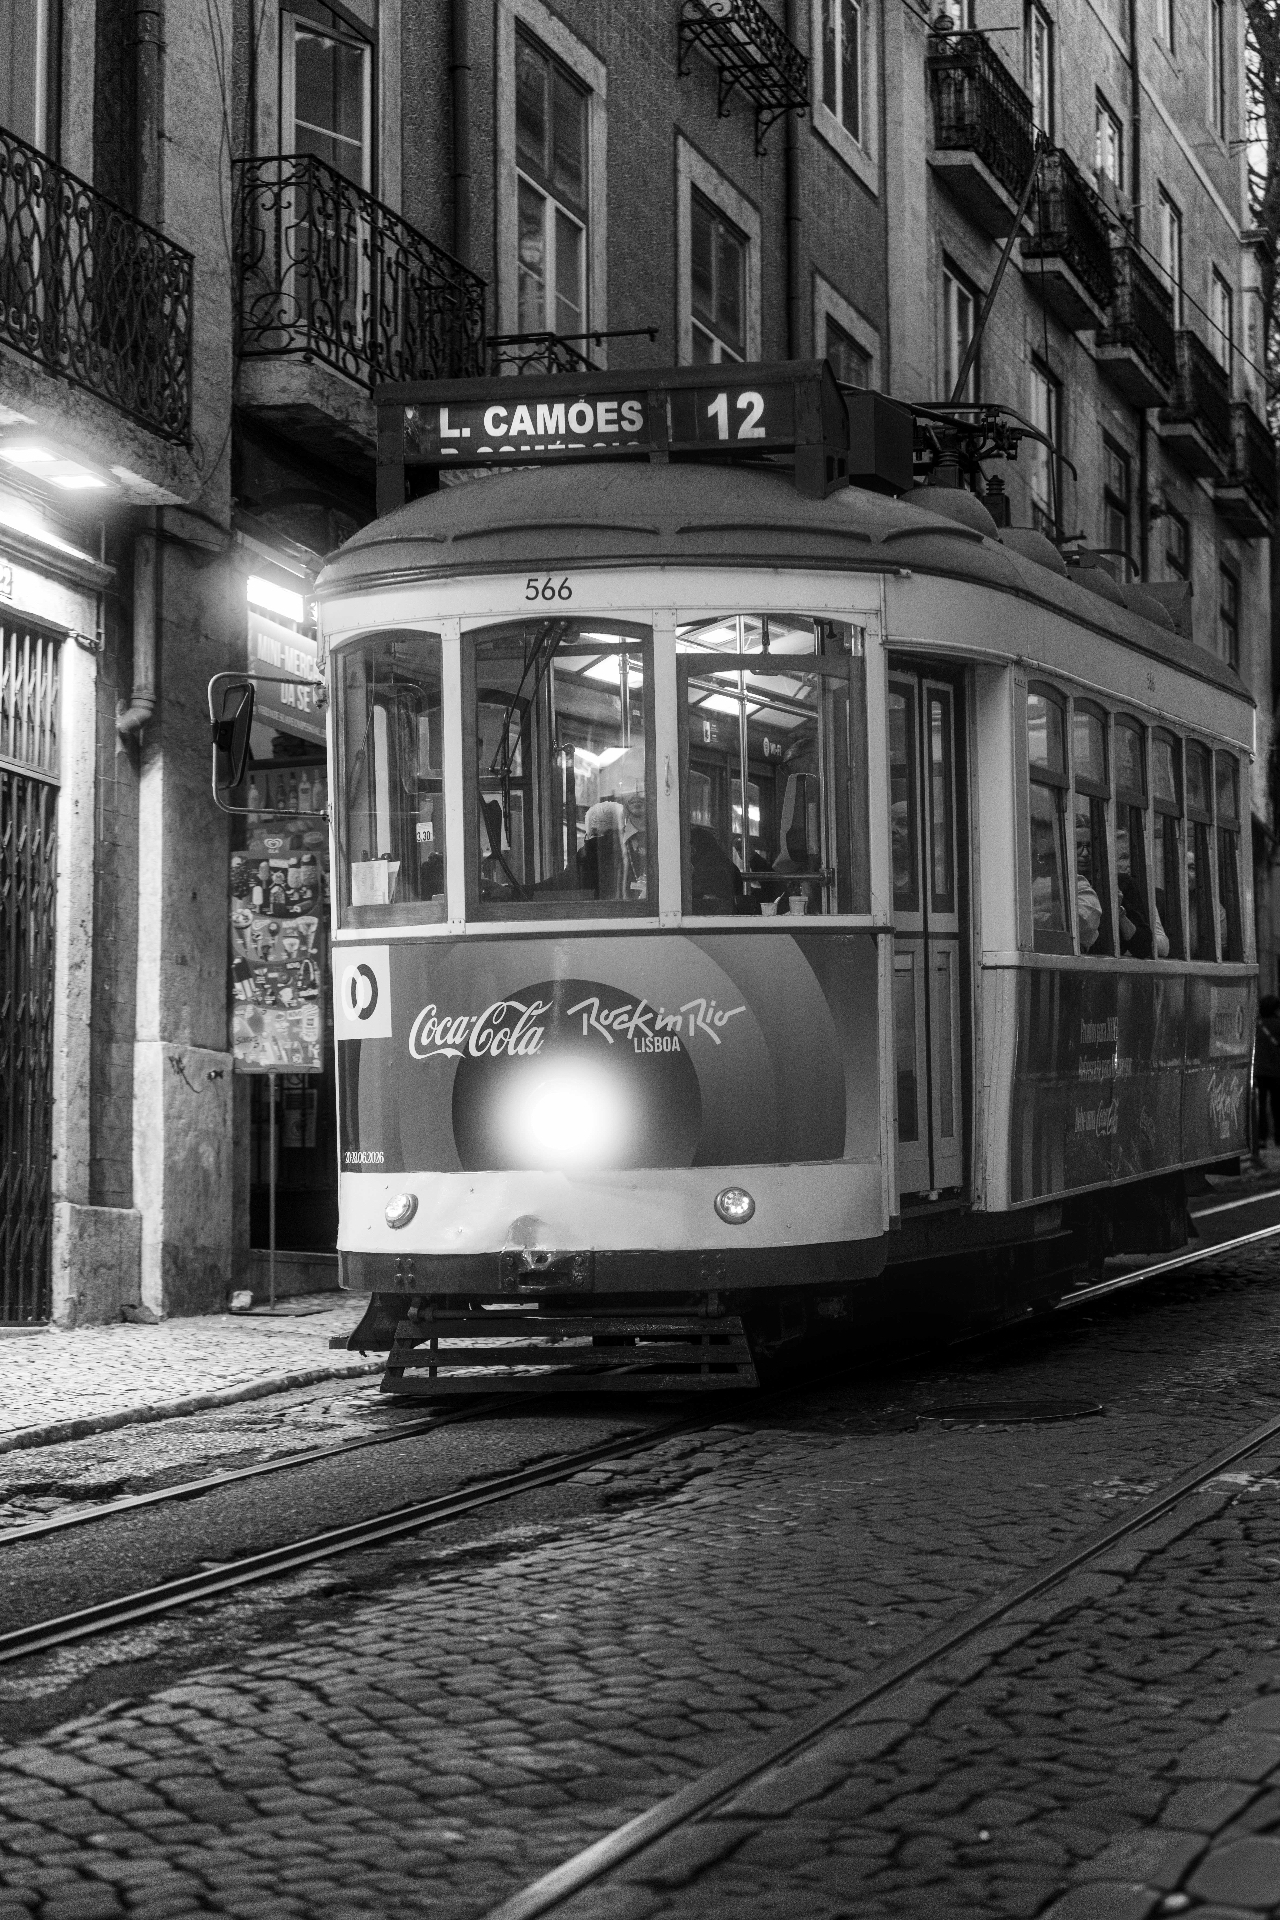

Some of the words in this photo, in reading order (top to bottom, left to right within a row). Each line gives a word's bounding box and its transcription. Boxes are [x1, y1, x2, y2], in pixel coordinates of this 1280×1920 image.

[439, 407, 471, 438] L.
[483, 398, 644, 437] CAMÕES
[707, 391, 766, 440] 12
[524, 577, 573, 601] 566
[408, 999, 553, 1060] Coca-Cola
[567, 997, 653, 1045] Rock
[654, 1001, 686, 1034] in
[687, 997, 746, 1046] Rio
[634, 1036, 681, 1053] LISBOA
